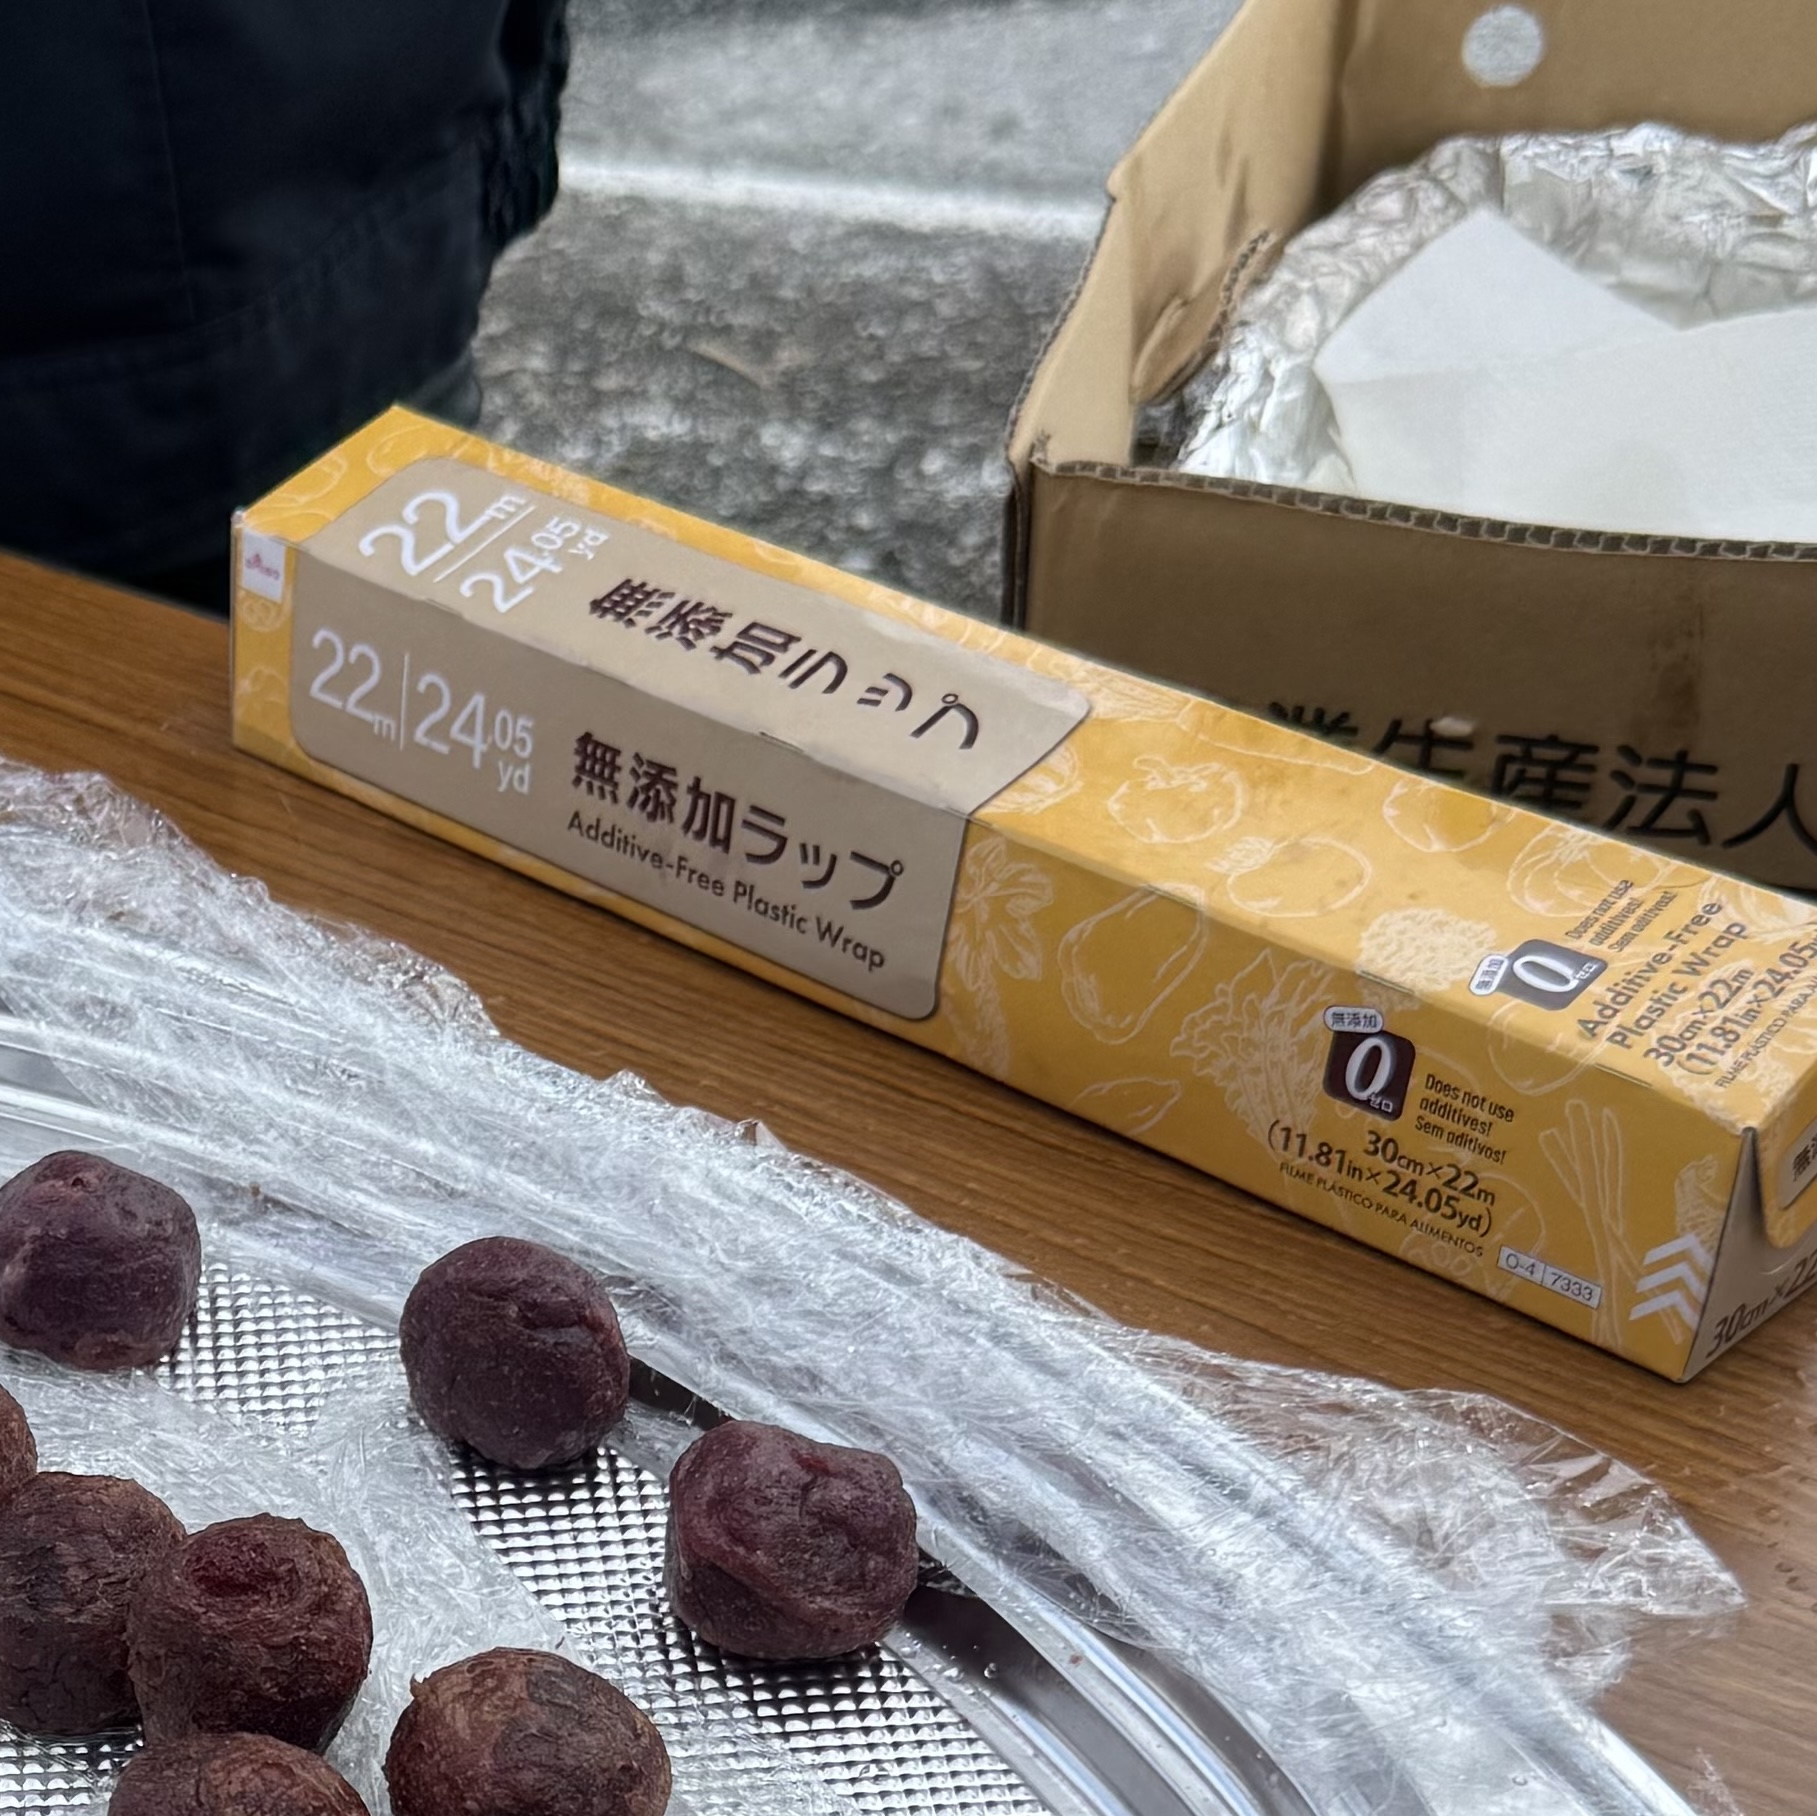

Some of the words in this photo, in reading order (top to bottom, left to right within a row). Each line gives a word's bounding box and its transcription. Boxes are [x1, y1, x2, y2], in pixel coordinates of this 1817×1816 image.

[571, 731, 905, 911] 無添加ラップ
[567, 810, 726, 898] Additive-Free
[733, 880, 810, 936] Plastic
[814, 915, 886, 973] Wrap
[1577, 902, 1723, 1039] Additive-Free
[1606, 981, 1689, 1050] Plastic
[1671, 921, 1749, 977] Wrap
[1415, 1115, 1445, 1141] Sem
[1446, 1131, 1507, 1165] aditivos!
[1419, 1098, 1494, 1137] additives!
[1425, 1073, 1461, 1101] Does
[1461, 1091, 1487, 1112] not
[1488, 1102, 1515, 1122] use
[1279, 1161, 1314, 1186] FILME
[1374, 1201, 1408, 1225] PARA
[1409, 1217, 1484, 1258] ALIMENTOS
[1551, 1272, 1593, 1302] 7333
